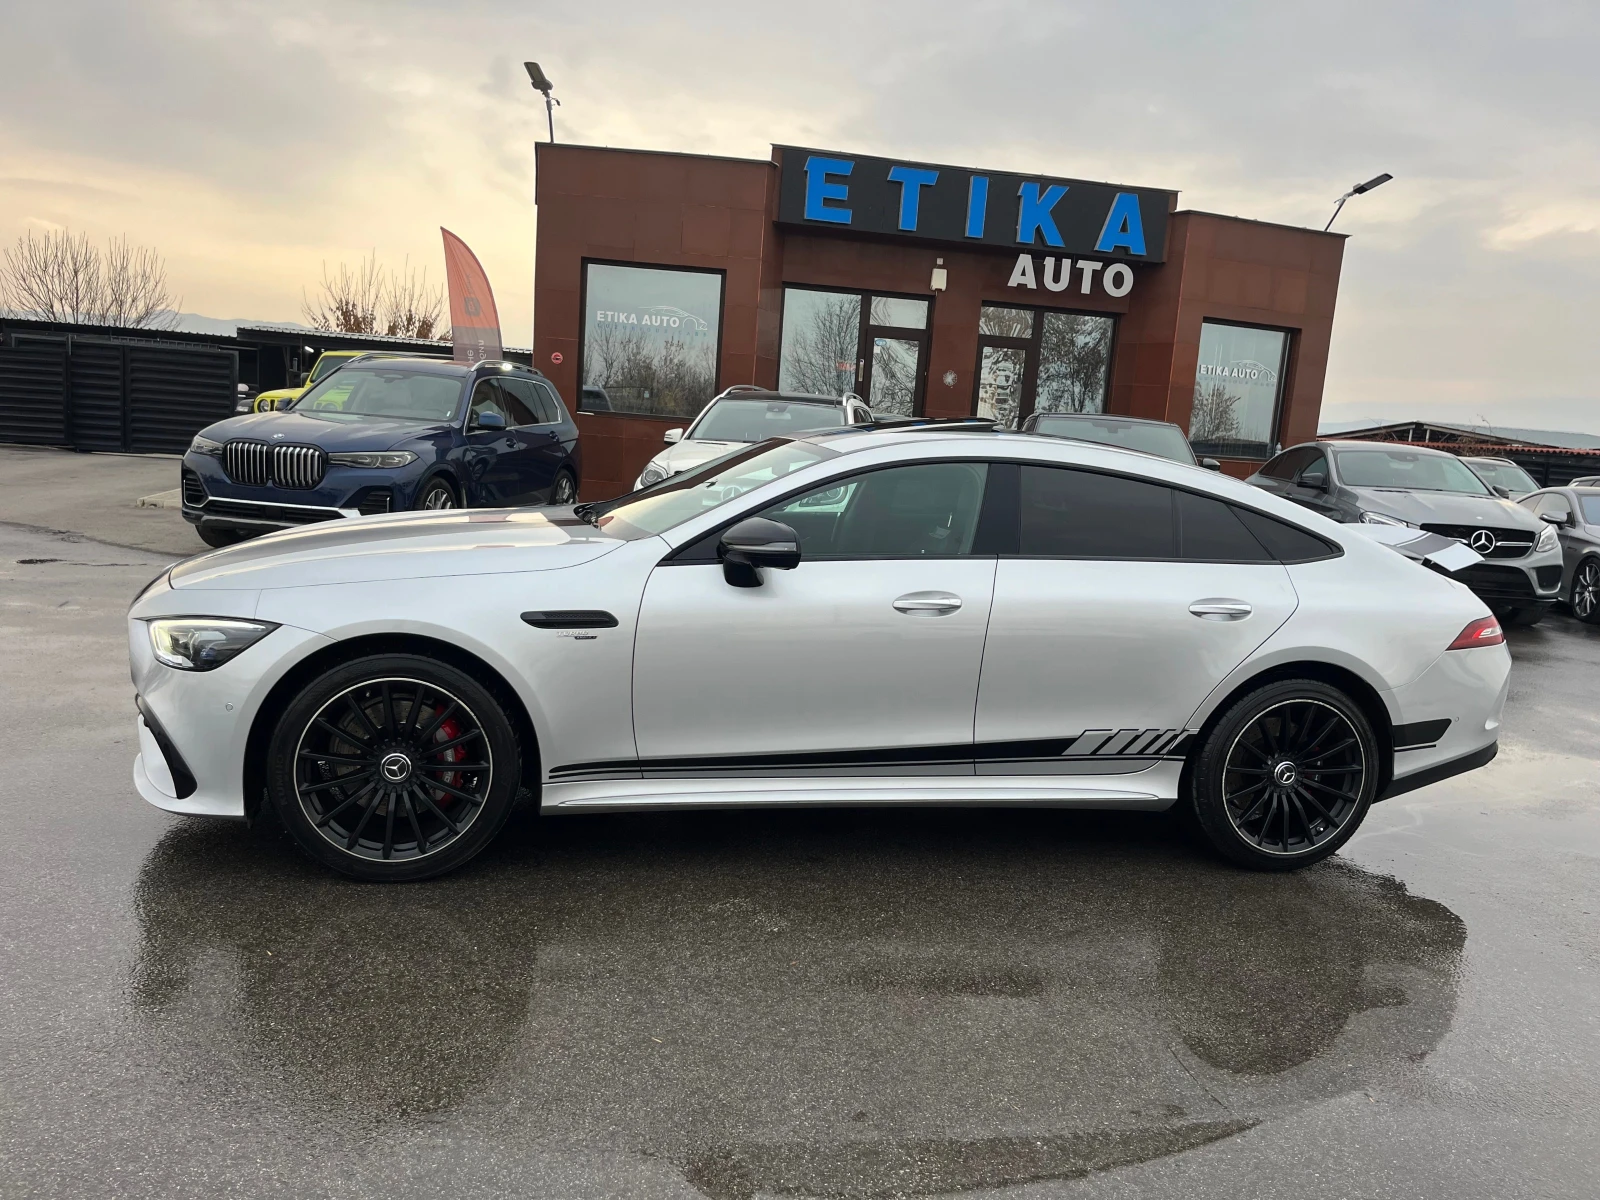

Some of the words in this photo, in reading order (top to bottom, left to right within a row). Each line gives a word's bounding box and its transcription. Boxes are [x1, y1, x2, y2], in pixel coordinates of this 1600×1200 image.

[803, 155, 1148, 257] ETIKA
[1007, 253, 1135, 298] AUTO
[596, 310, 638, 325] ETIKA
[641, 314, 680, 328] AUTO
[1199, 364, 1229, 377] ETIKA
[1231, 367, 1259, 380] AUTO
